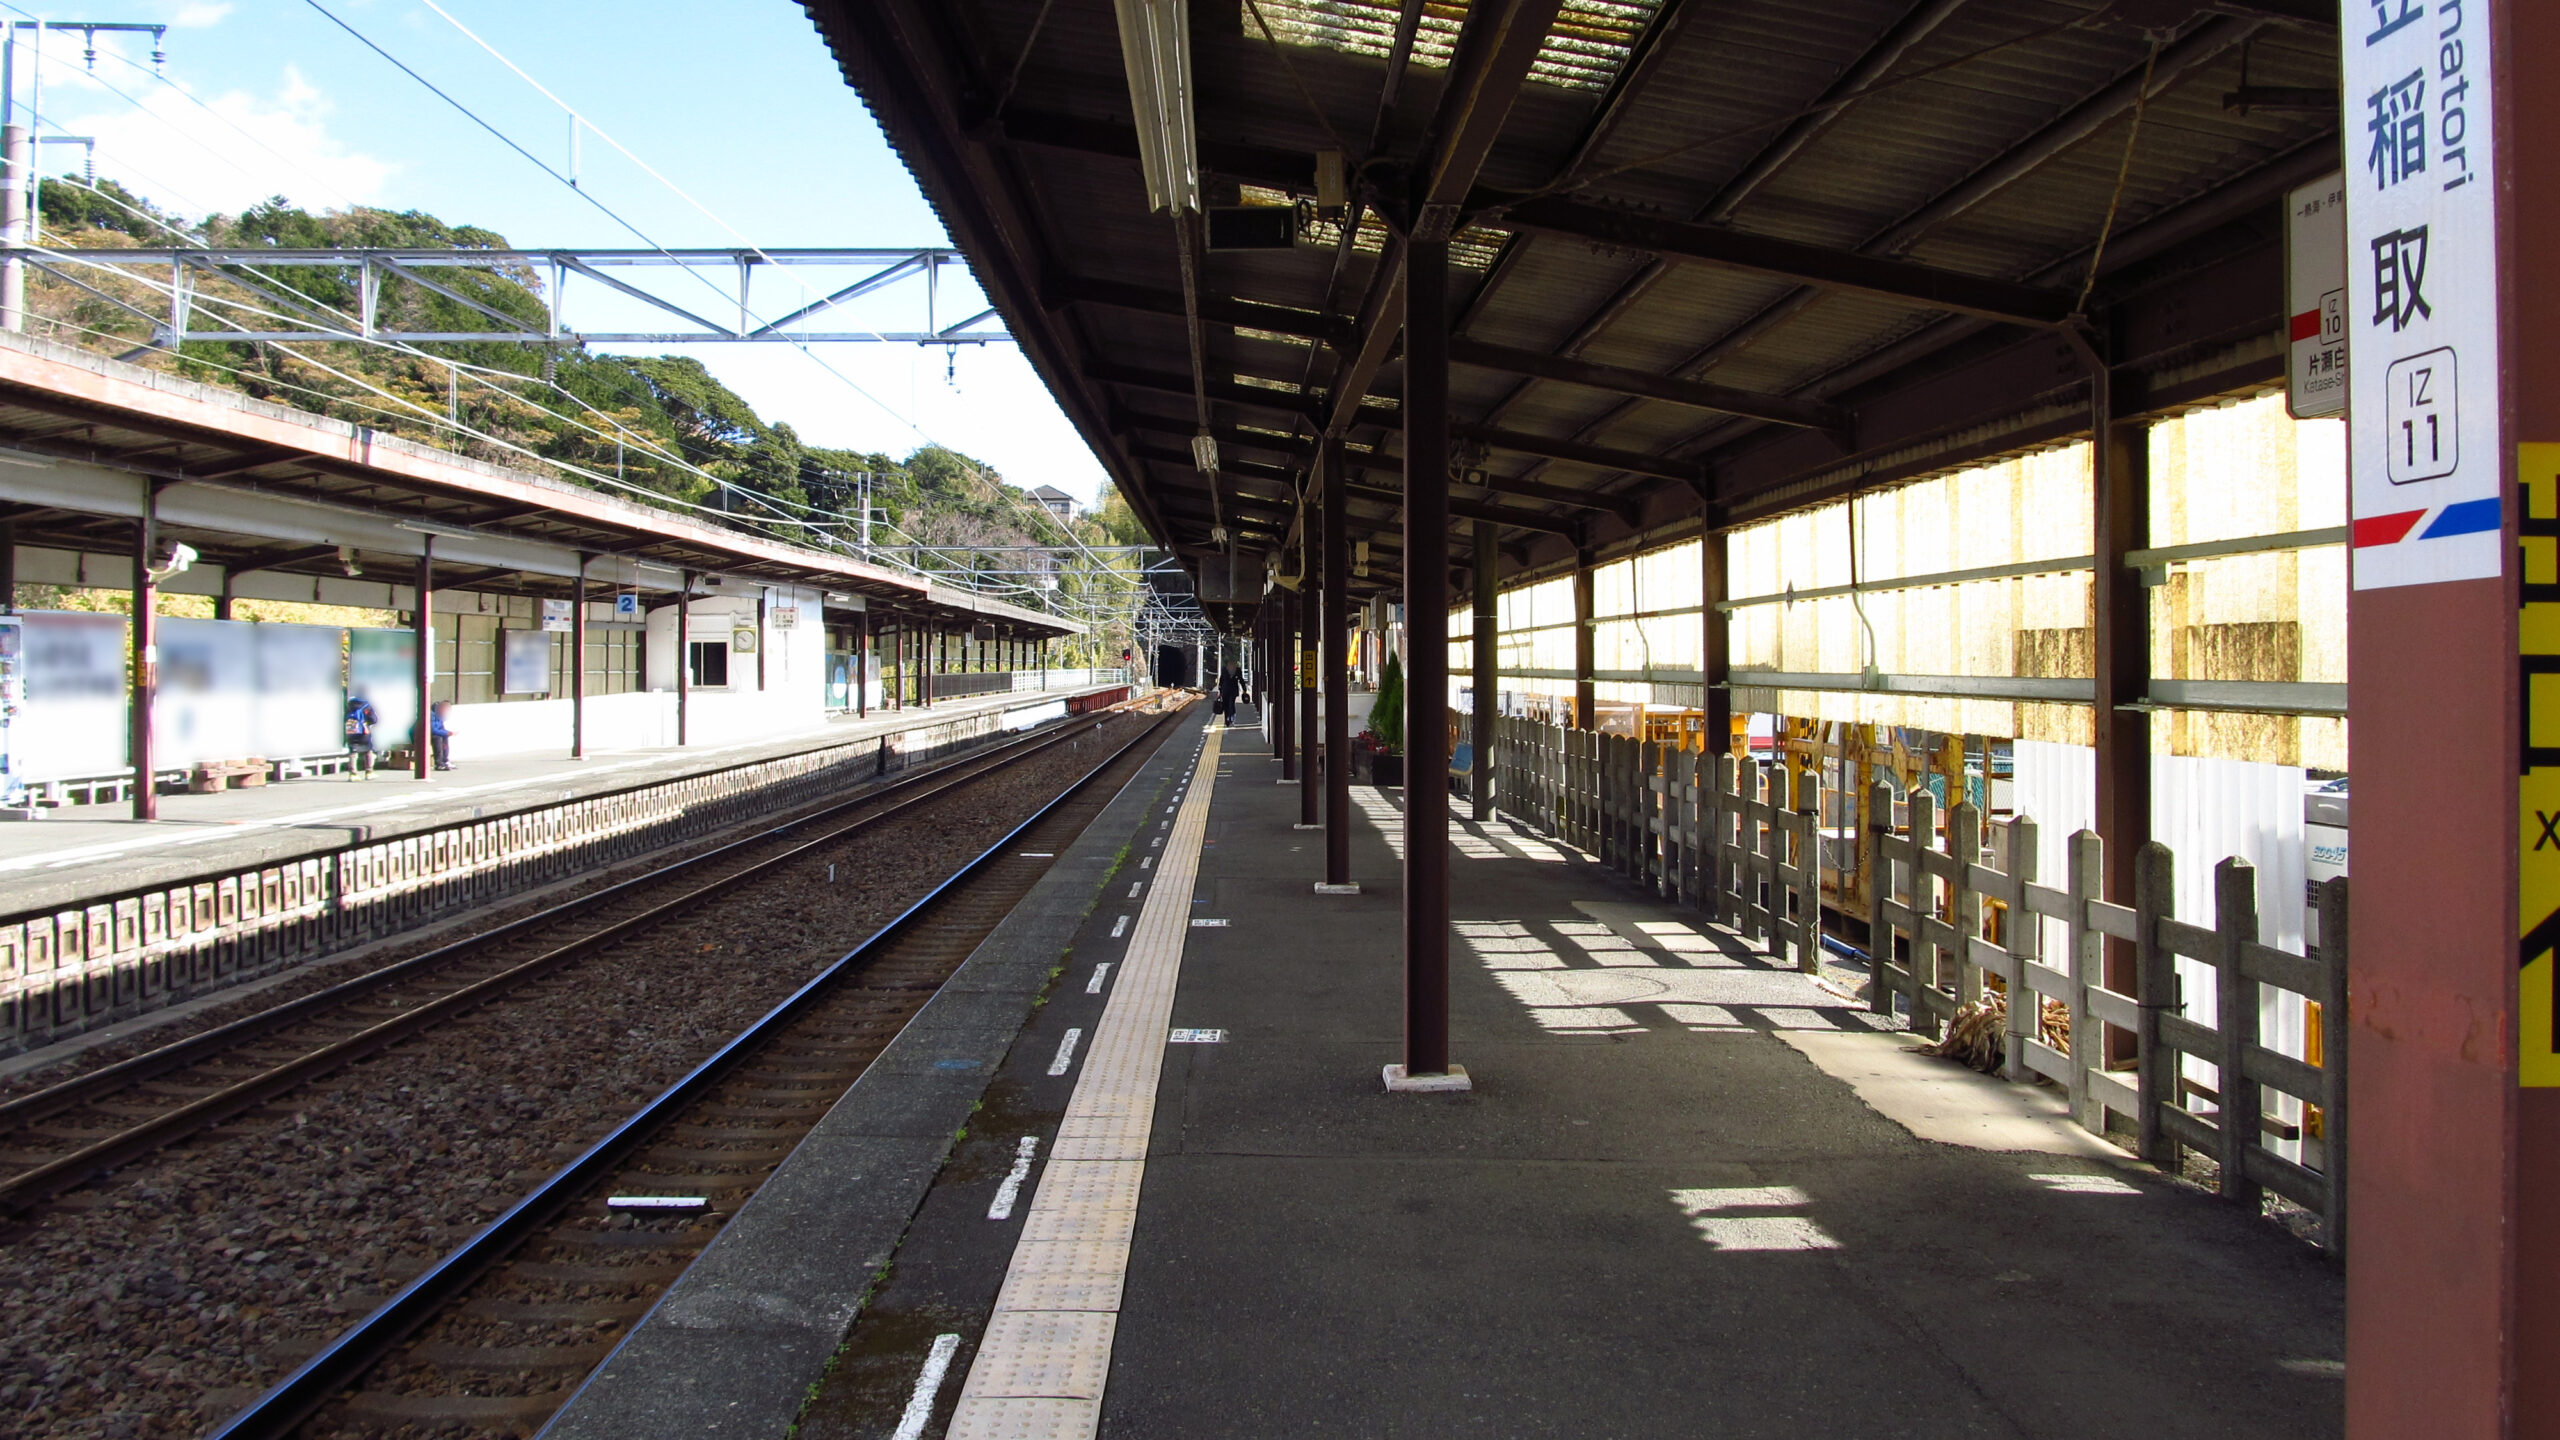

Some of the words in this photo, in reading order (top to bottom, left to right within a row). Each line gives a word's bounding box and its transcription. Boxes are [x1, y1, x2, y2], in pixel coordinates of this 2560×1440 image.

[2366, 0, 2432, 332] 稲取
[2325, 315, 2341, 336] 10
[2409, 368, 2432, 407] IZ
[2402, 414, 2440, 467] 11
[621, 597, 632, 612] 2
[1305, 652, 1313, 670] 出口
